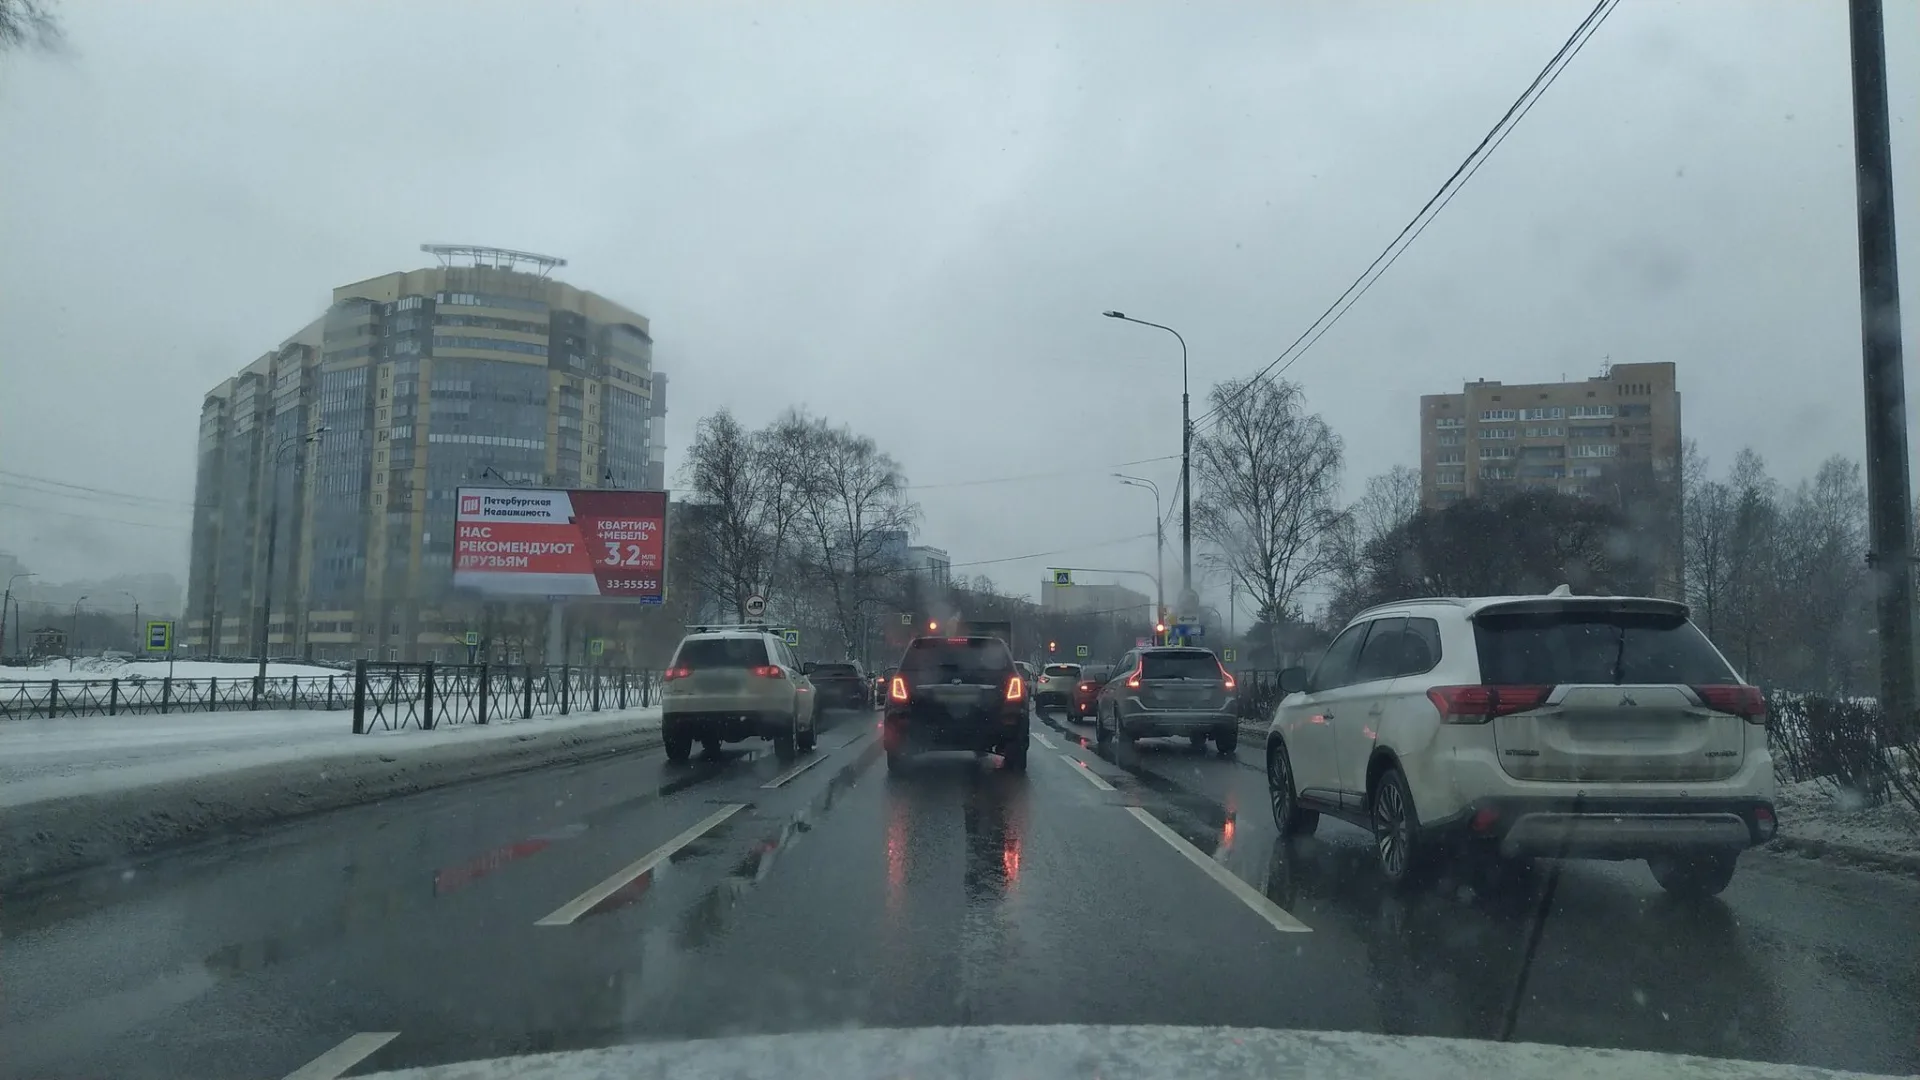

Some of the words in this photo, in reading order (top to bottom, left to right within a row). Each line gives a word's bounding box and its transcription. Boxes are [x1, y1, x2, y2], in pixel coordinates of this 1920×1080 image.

[463, 499, 478, 512] ПН
[484, 496, 551, 507] Петербургская
[484, 507, 551, 517] Недвижимость
[597, 520, 657, 530] КВАРТИРА
[460, 526, 492, 538] НАС
[596, 531, 649, 541] +МЕБЕЛЬ
[459, 540, 575, 555] РЕКОМЕНДУЮТ
[604, 542, 640, 567] 3,2
[458, 555, 528, 568] ДРУЗЬЯМ
[606, 579, 657, 590] 33-55555
